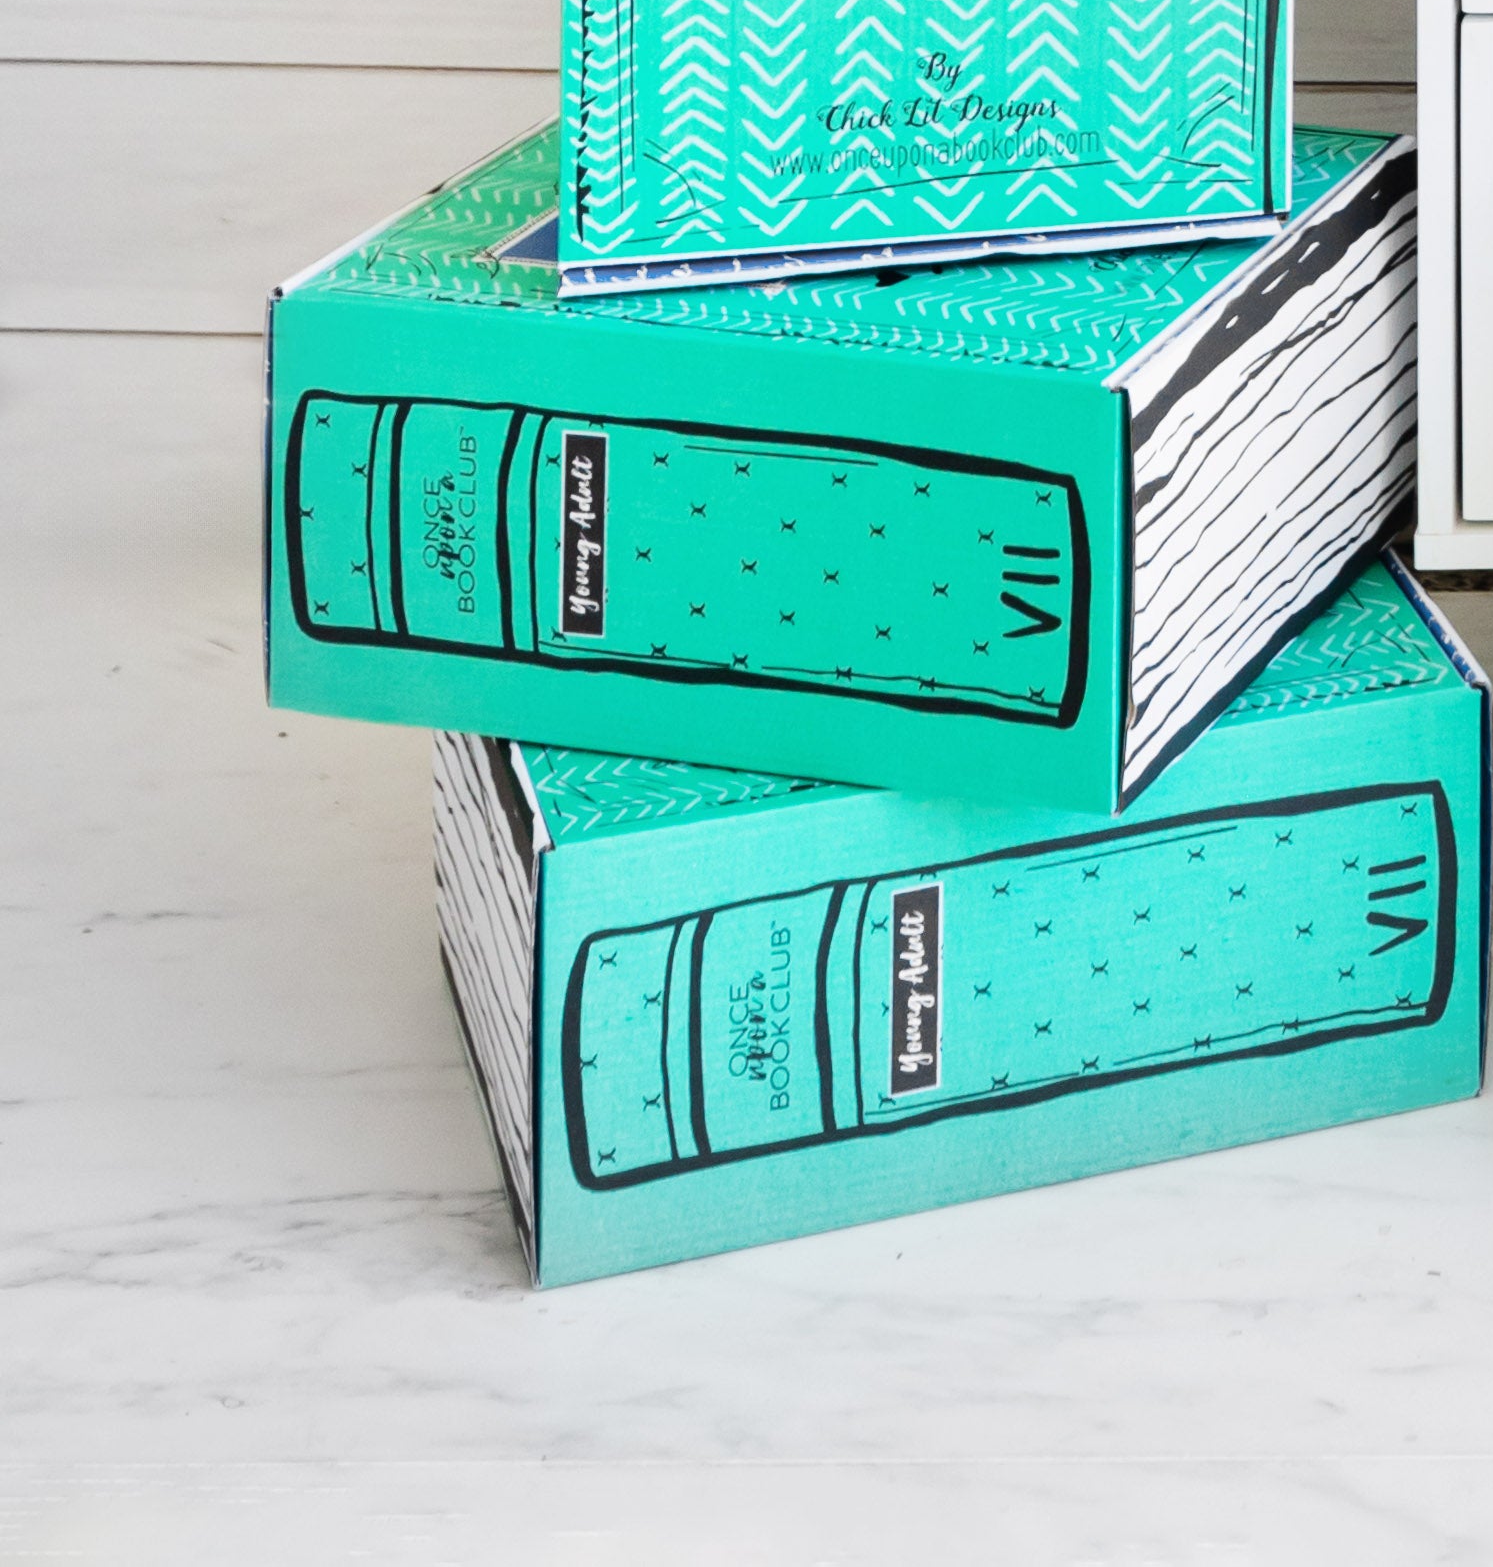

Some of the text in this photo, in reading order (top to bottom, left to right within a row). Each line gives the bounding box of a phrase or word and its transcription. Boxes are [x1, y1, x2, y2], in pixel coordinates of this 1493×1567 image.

[816, 95, 1062, 133] Chick Lit Designs
[916, 52, 964, 92] By
[769, 124, 1100, 177] www.onceuponabookclub.com
[423, 477, 441, 569] ONCE
[457, 524, 476, 614] BOOK
[568, 455, 602, 615] Young Adult
[1000, 545, 1062, 638] VII
[1366, 855, 1428, 956] VII
[728, 982, 750, 1077] ONCE
[898, 910, 935, 1073] Young Adult
[770, 1016, 791, 1112] BOOK
